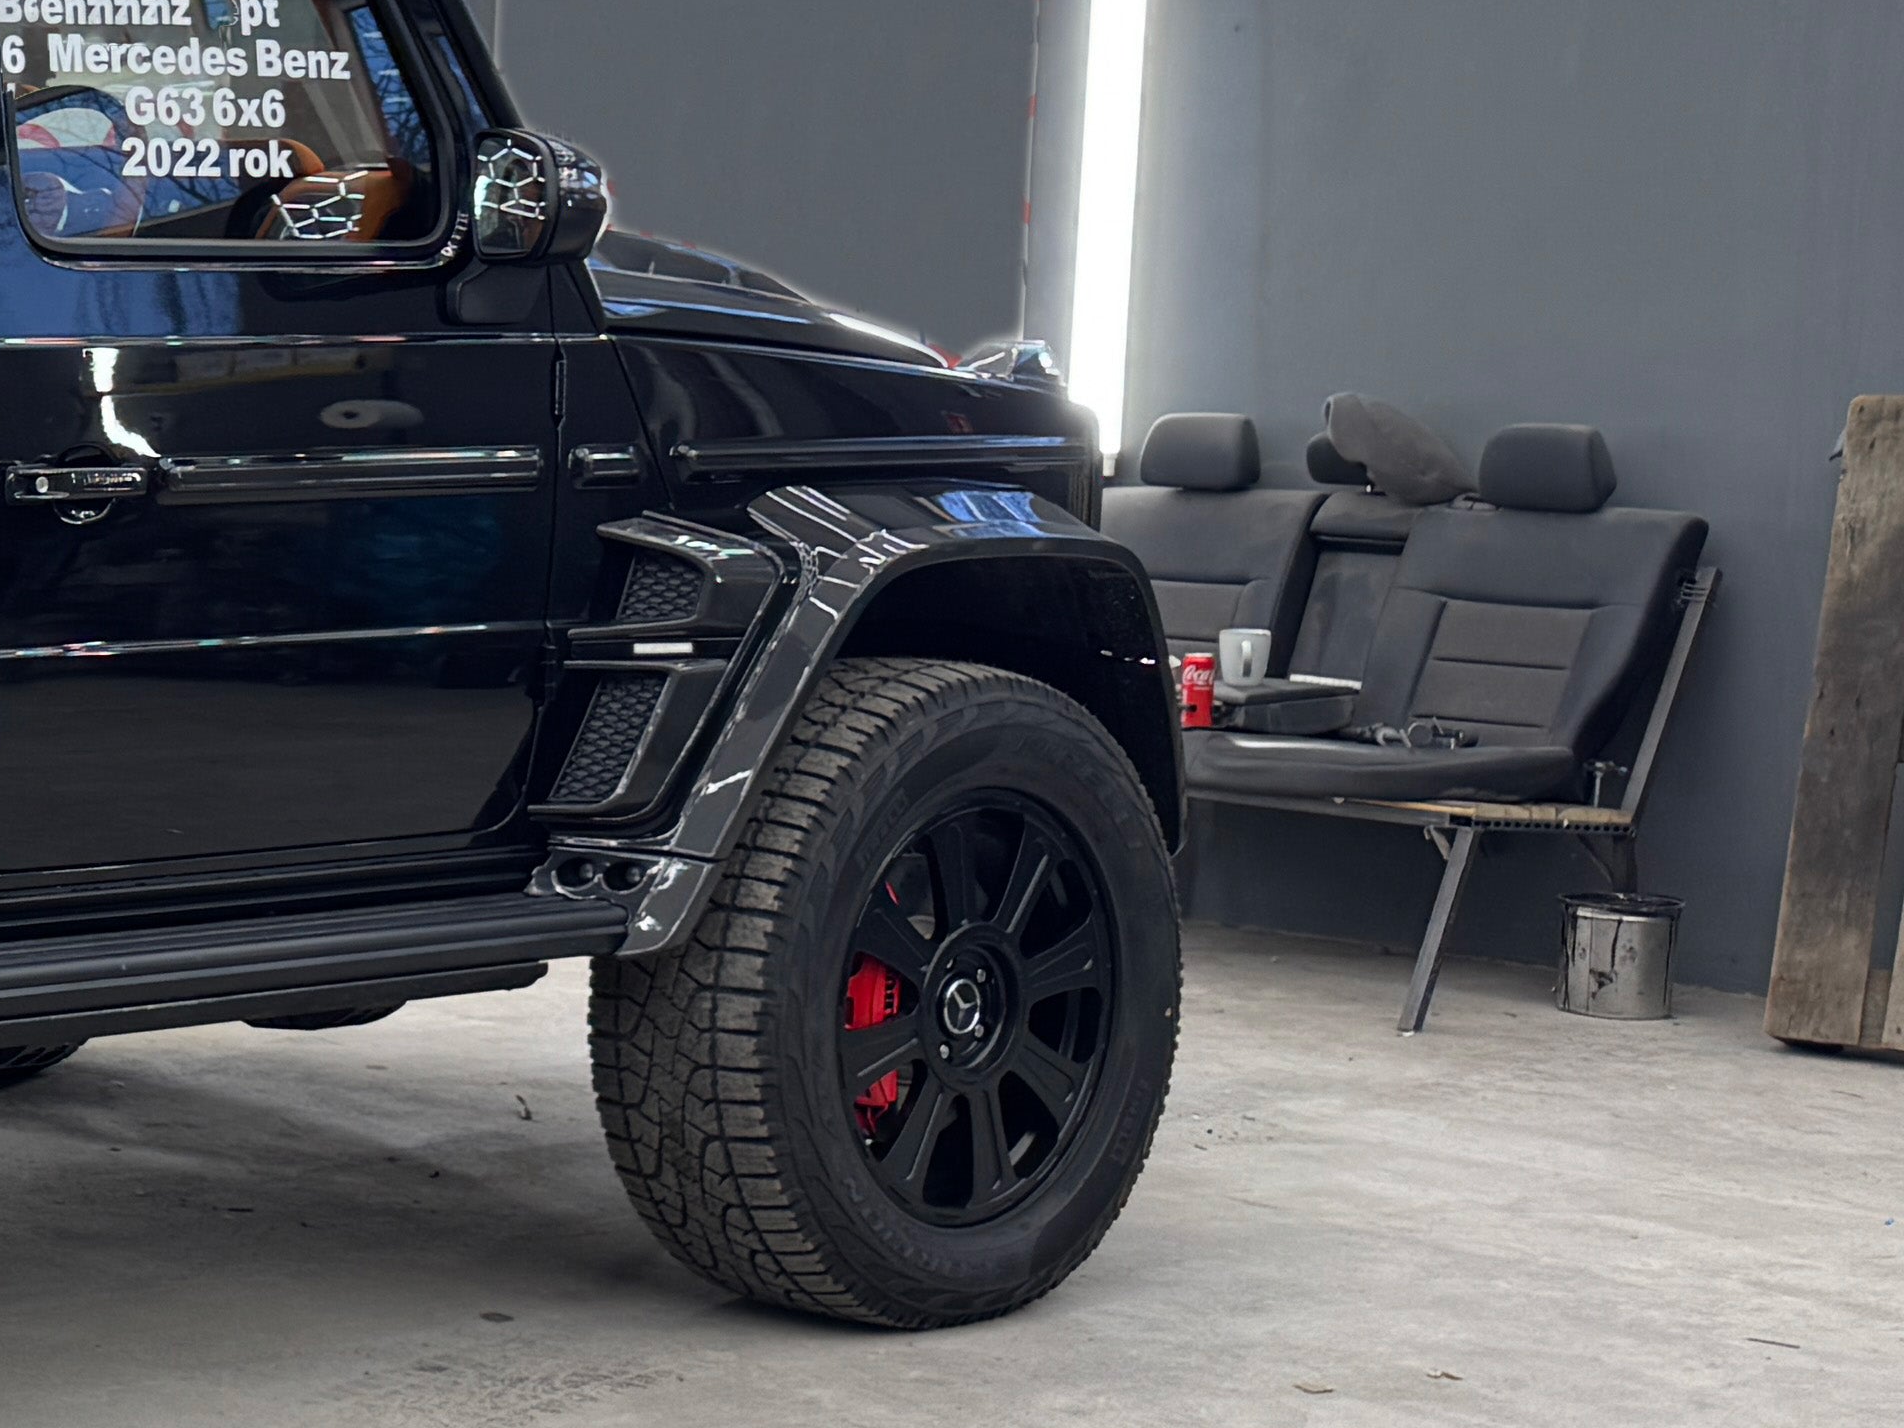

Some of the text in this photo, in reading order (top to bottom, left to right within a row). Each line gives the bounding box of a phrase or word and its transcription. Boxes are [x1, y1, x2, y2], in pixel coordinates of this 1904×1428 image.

[47, 33, 248, 76] Mercedes
[257, 40, 350, 80] Benz
[125, 86, 286, 127] G63 6x6
[122, 138, 293, 178] 2022 rok
